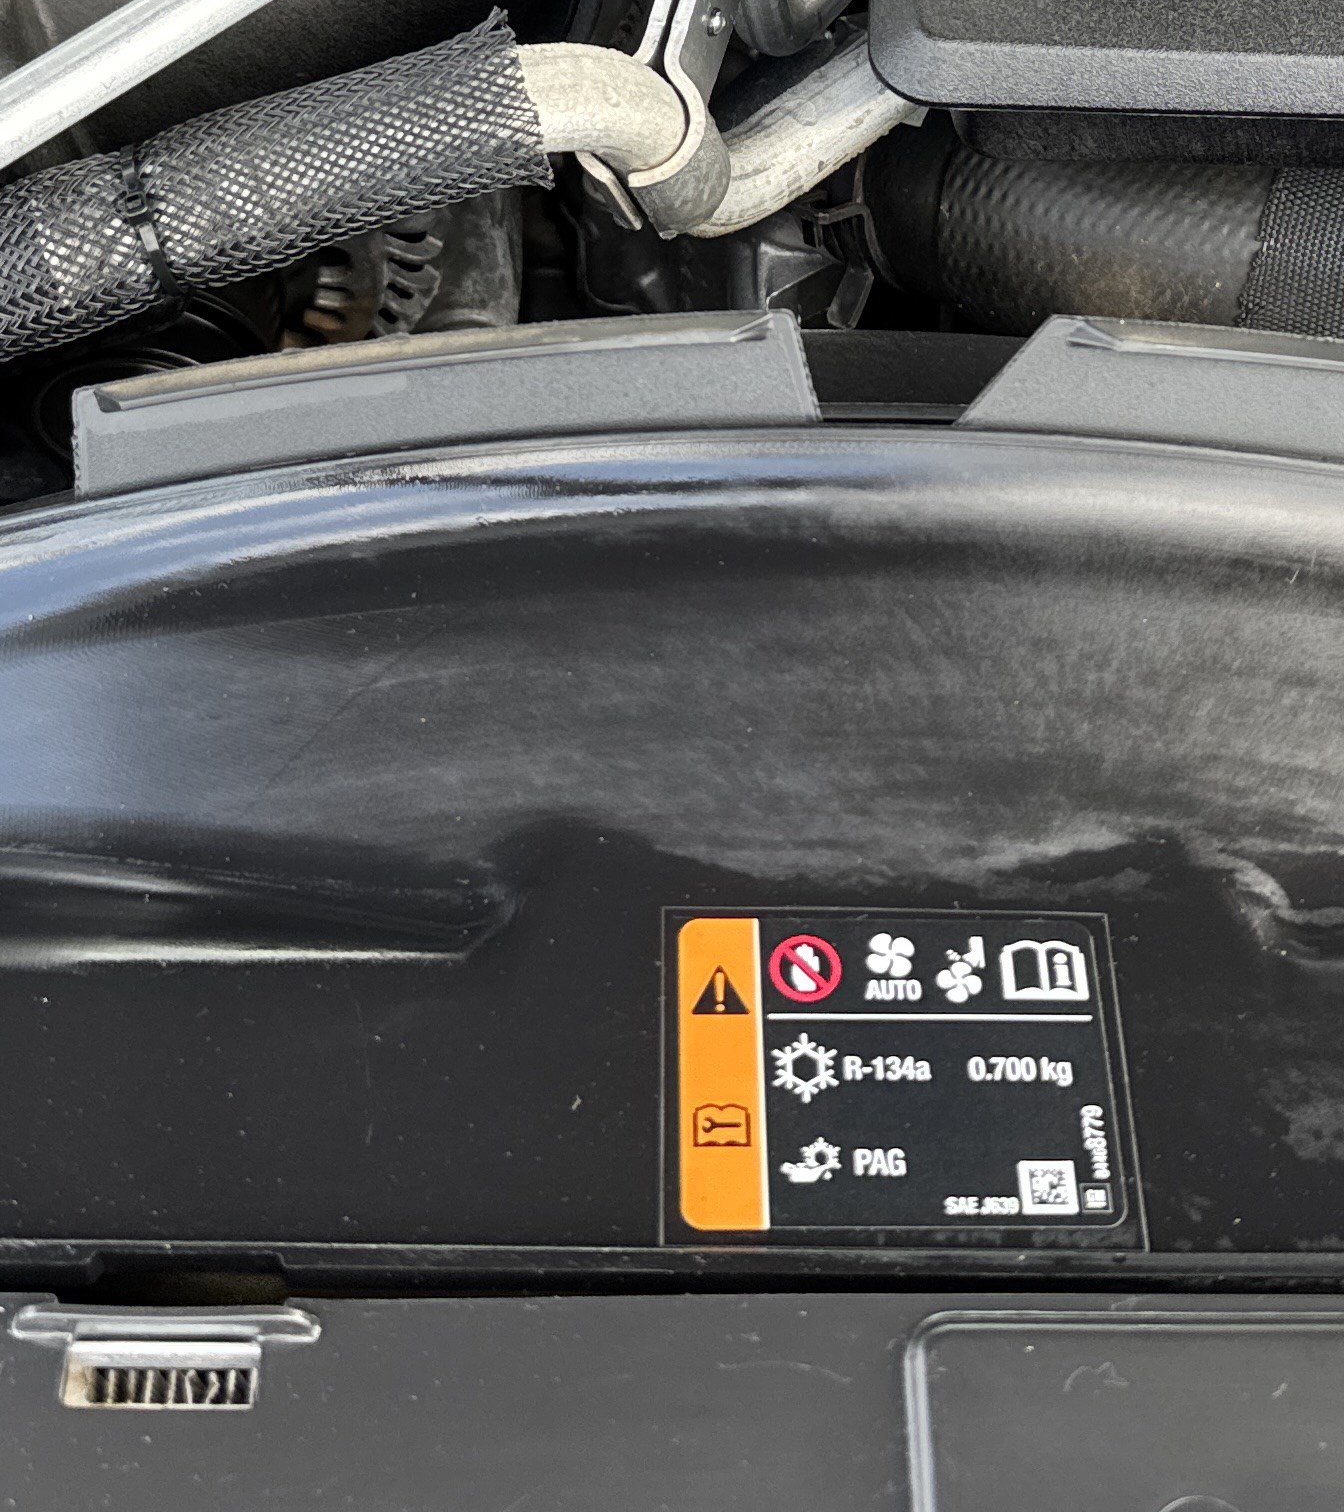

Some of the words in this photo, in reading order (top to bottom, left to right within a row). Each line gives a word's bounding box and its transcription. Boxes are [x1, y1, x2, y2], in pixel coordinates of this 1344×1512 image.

[864, 979, 923, 1001] AUTO
[843, 1054, 932, 1082] R-134a
[967, 1055, 1038, 1082] 0.700
[1040, 1055, 1074, 1087] kg
[852, 1147, 907, 1177] PAG
[943, 1196, 979, 1216] SAE
